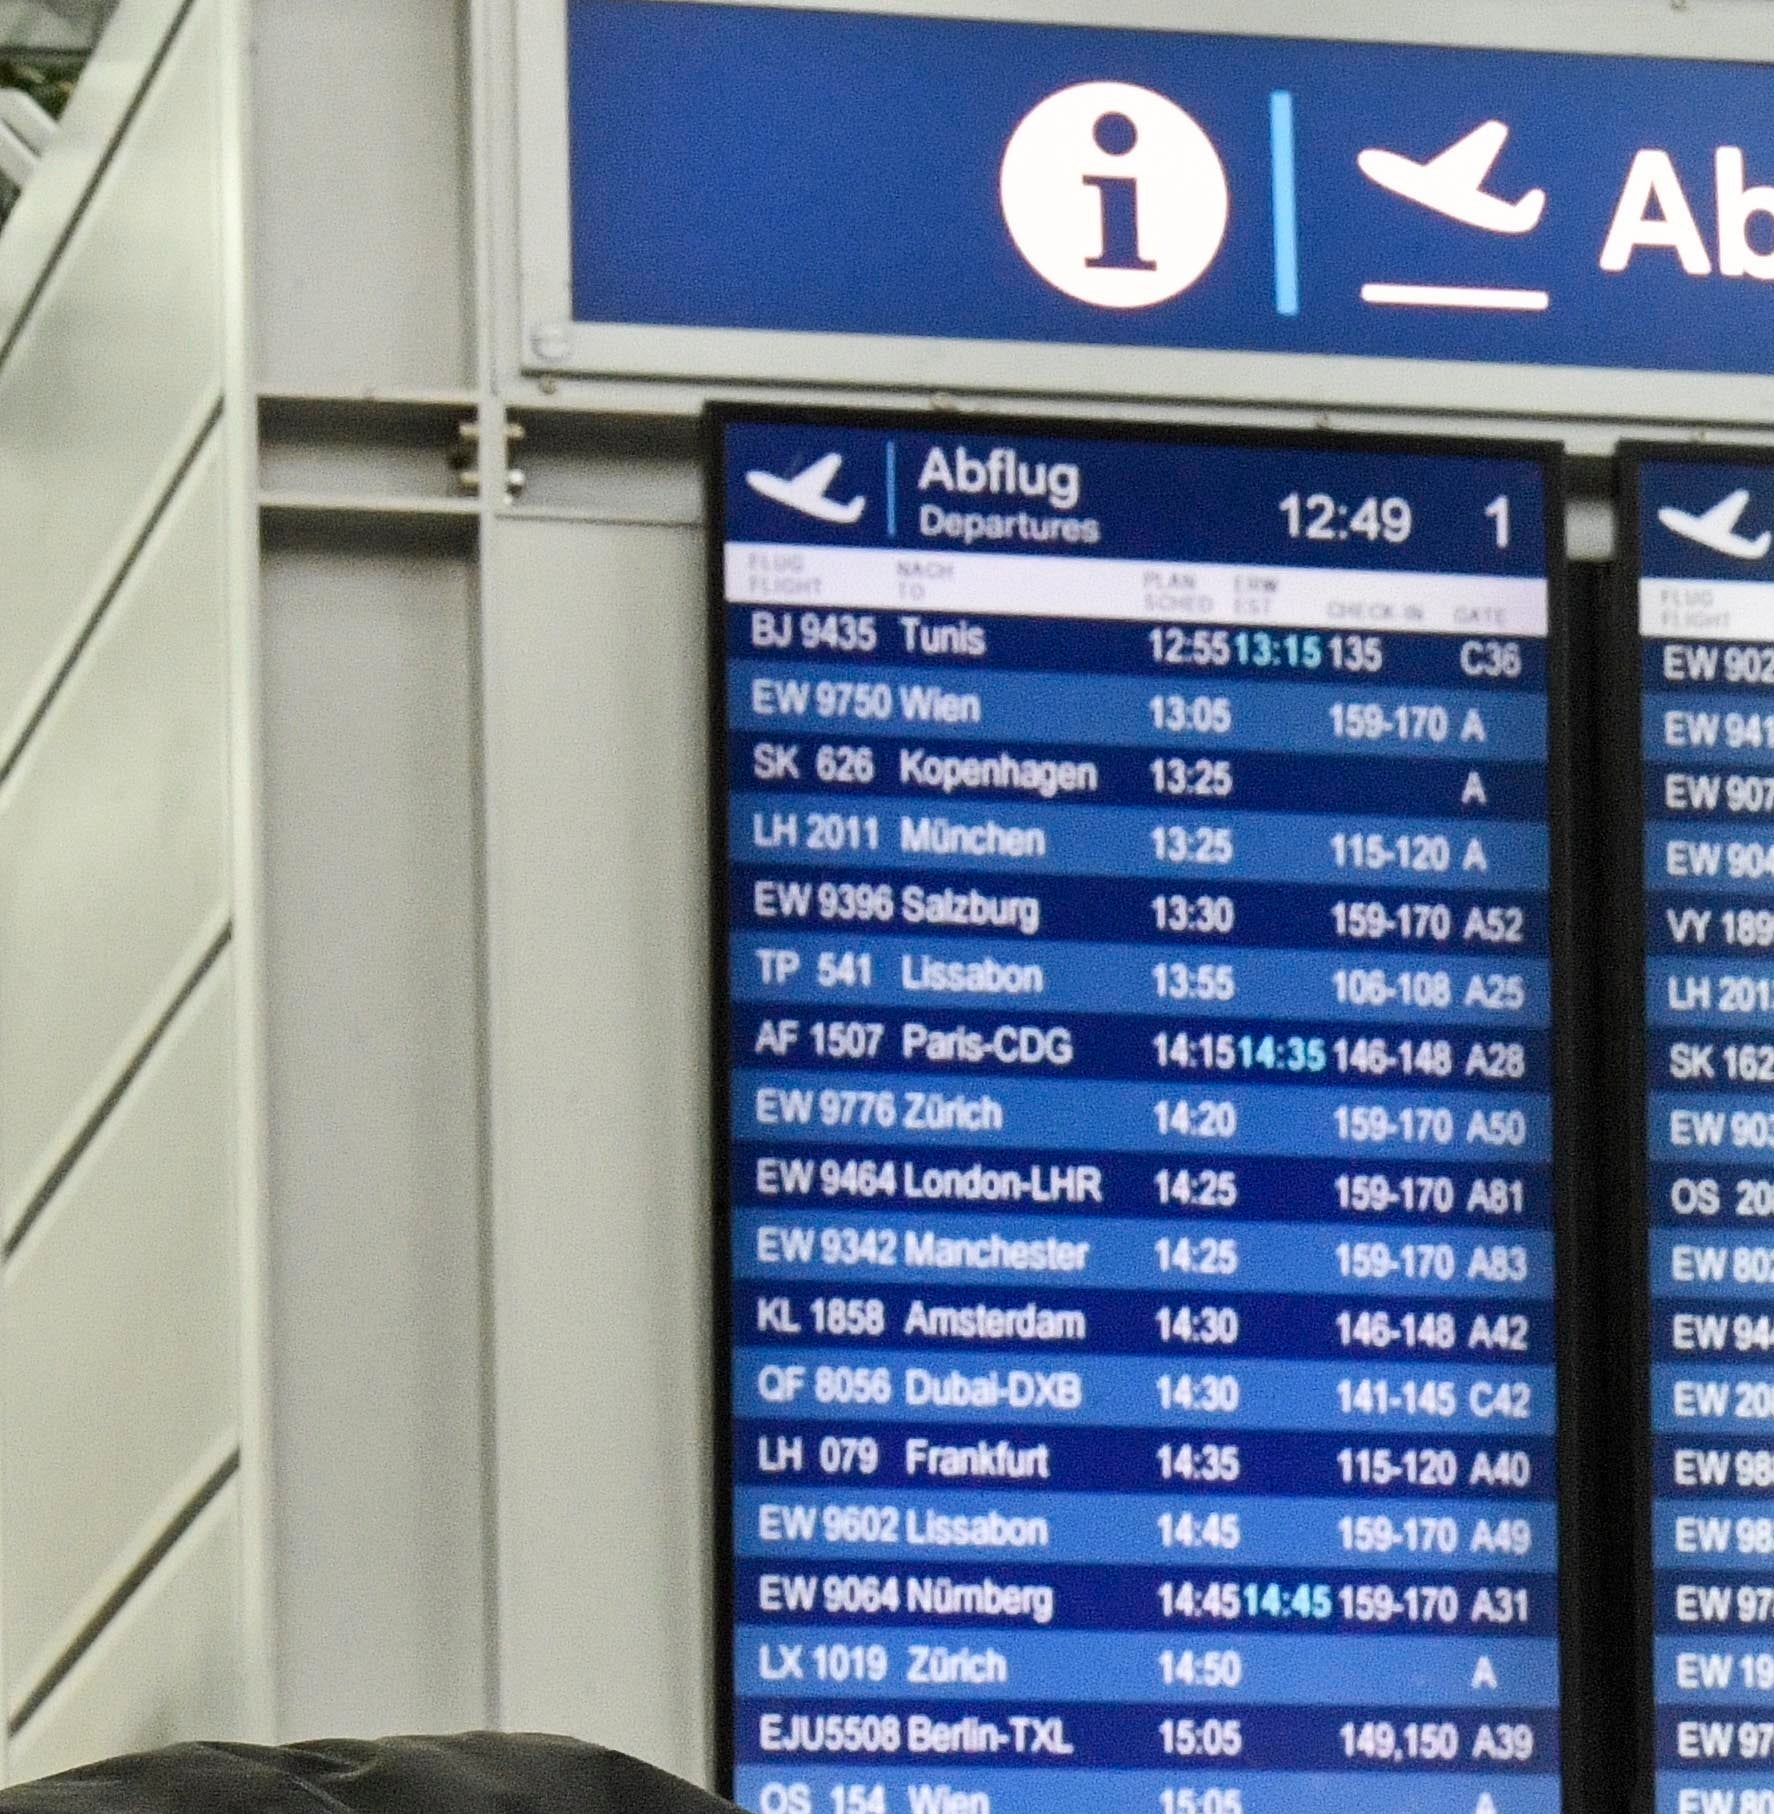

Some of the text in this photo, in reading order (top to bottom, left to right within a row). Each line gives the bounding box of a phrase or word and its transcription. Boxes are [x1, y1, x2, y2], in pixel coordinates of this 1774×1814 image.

[918, 446, 1509, 548] Abflug 12:49 1
[919, 503, 1101, 544] Departures
[897, 560, 955, 581] NACH
[1144, 571, 1198, 591] PLAN
[897, 582, 926, 600] TO
[751, 610, 793, 648] BJ
[800, 612, 877, 652] 9435
[899, 616, 987, 656] Tunis
[1149, 627, 1231, 666] 12:55
[1235, 631, 1322, 668] 13:15
[1328, 635, 1383, 672] 135
[1663, 644, 1719, 680] EW
[752, 678, 1486, 742] EW 9750 Wien 13:05 159-170 A
[753, 813, 1488, 872] LH 2011 München 13:25 115-120 A
[754, 880, 1523, 943] EW 9396 Salzburg 13:30 159-170 A52
[1666, 908, 1712, 943] VY
[755, 1019, 799, 1055] AF
[810, 1021, 885, 1058] 1507
[902, 1022, 1074, 1065] Paris-CDG
[1153, 1032, 1236, 1070] 14:15
[1238, 1035, 1327, 1072] 14:35
[1333, 1037, 1453, 1077] 146-148
[1670, 1177, 1721, 1215] OS
[757, 1297, 1529, 1351] KL 1858 Amsterdam 14:30 146-148 A42
[758, 1435, 1530, 1487] LH 079 Frankfurt 14:35 115-120 A40
[759, 1574, 1528, 1624] EW 9064 Nürnberg 14:45 14:45 159-170 A31
[1677, 1652, 1734, 1689] EW
[759, 1713, 1534, 1761] EJU5508 Berlin-TXL 15:05 149,150 A39
